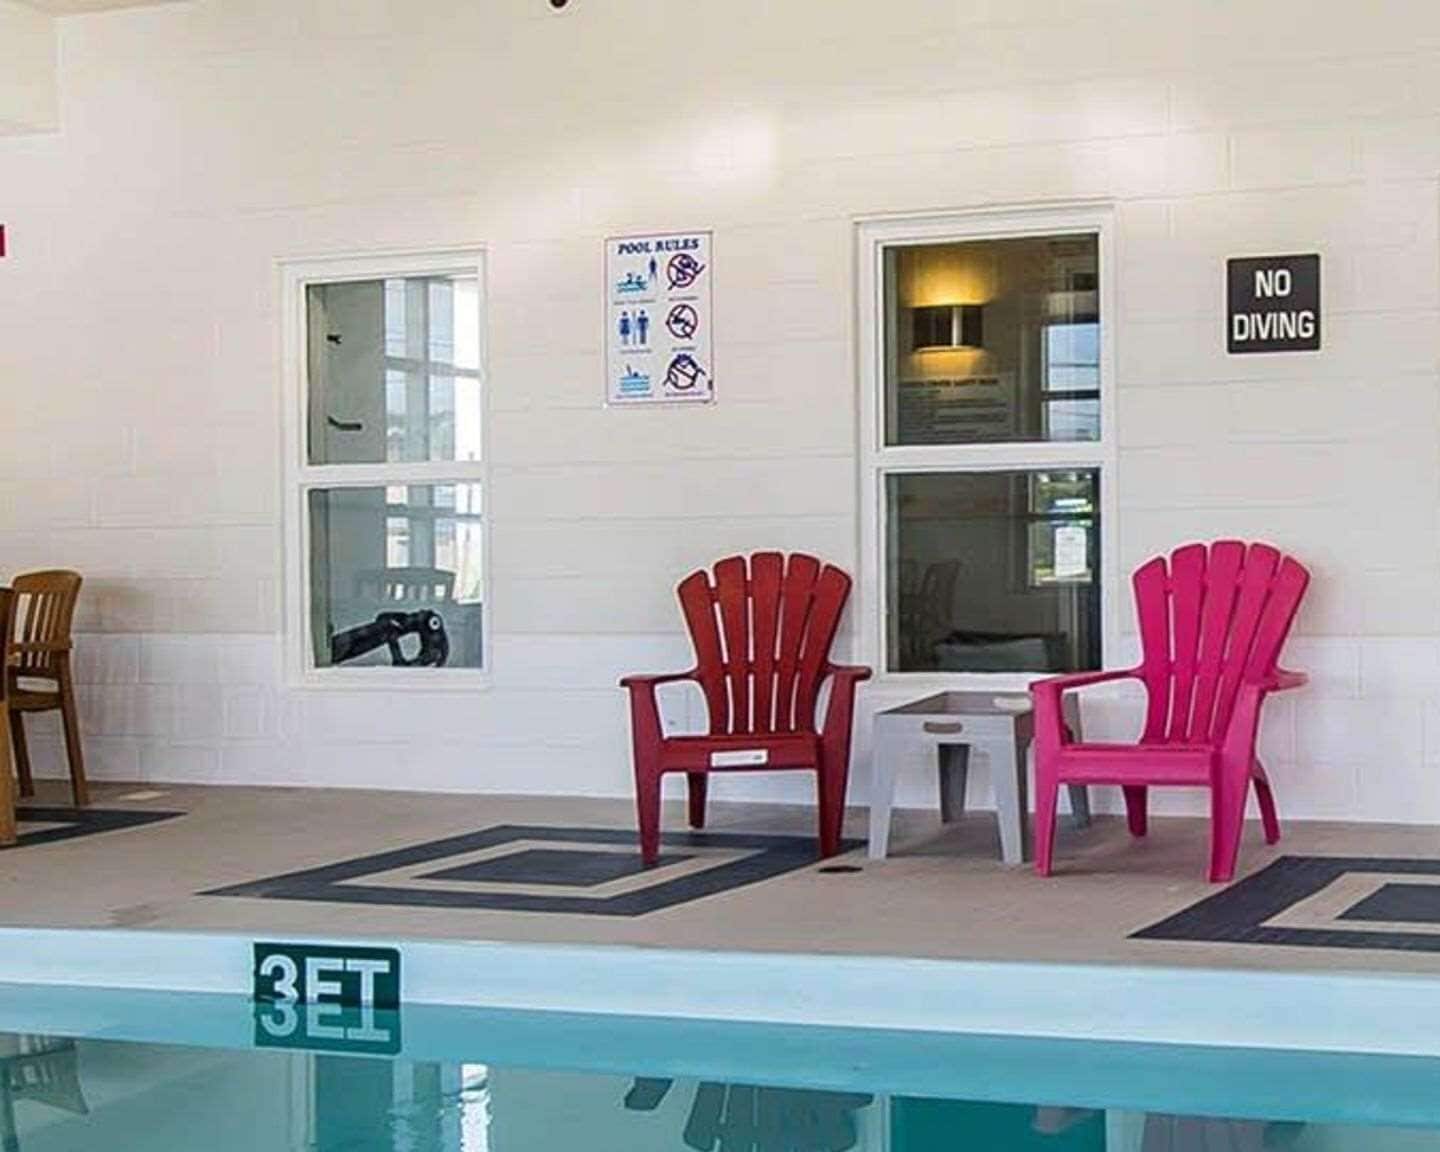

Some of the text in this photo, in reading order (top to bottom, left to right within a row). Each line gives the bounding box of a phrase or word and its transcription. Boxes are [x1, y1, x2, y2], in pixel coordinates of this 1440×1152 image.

[617, 239, 699, 255] POOL RULES
[1255, 269, 1292, 298] NO
[1233, 310, 1315, 341] DIVING
